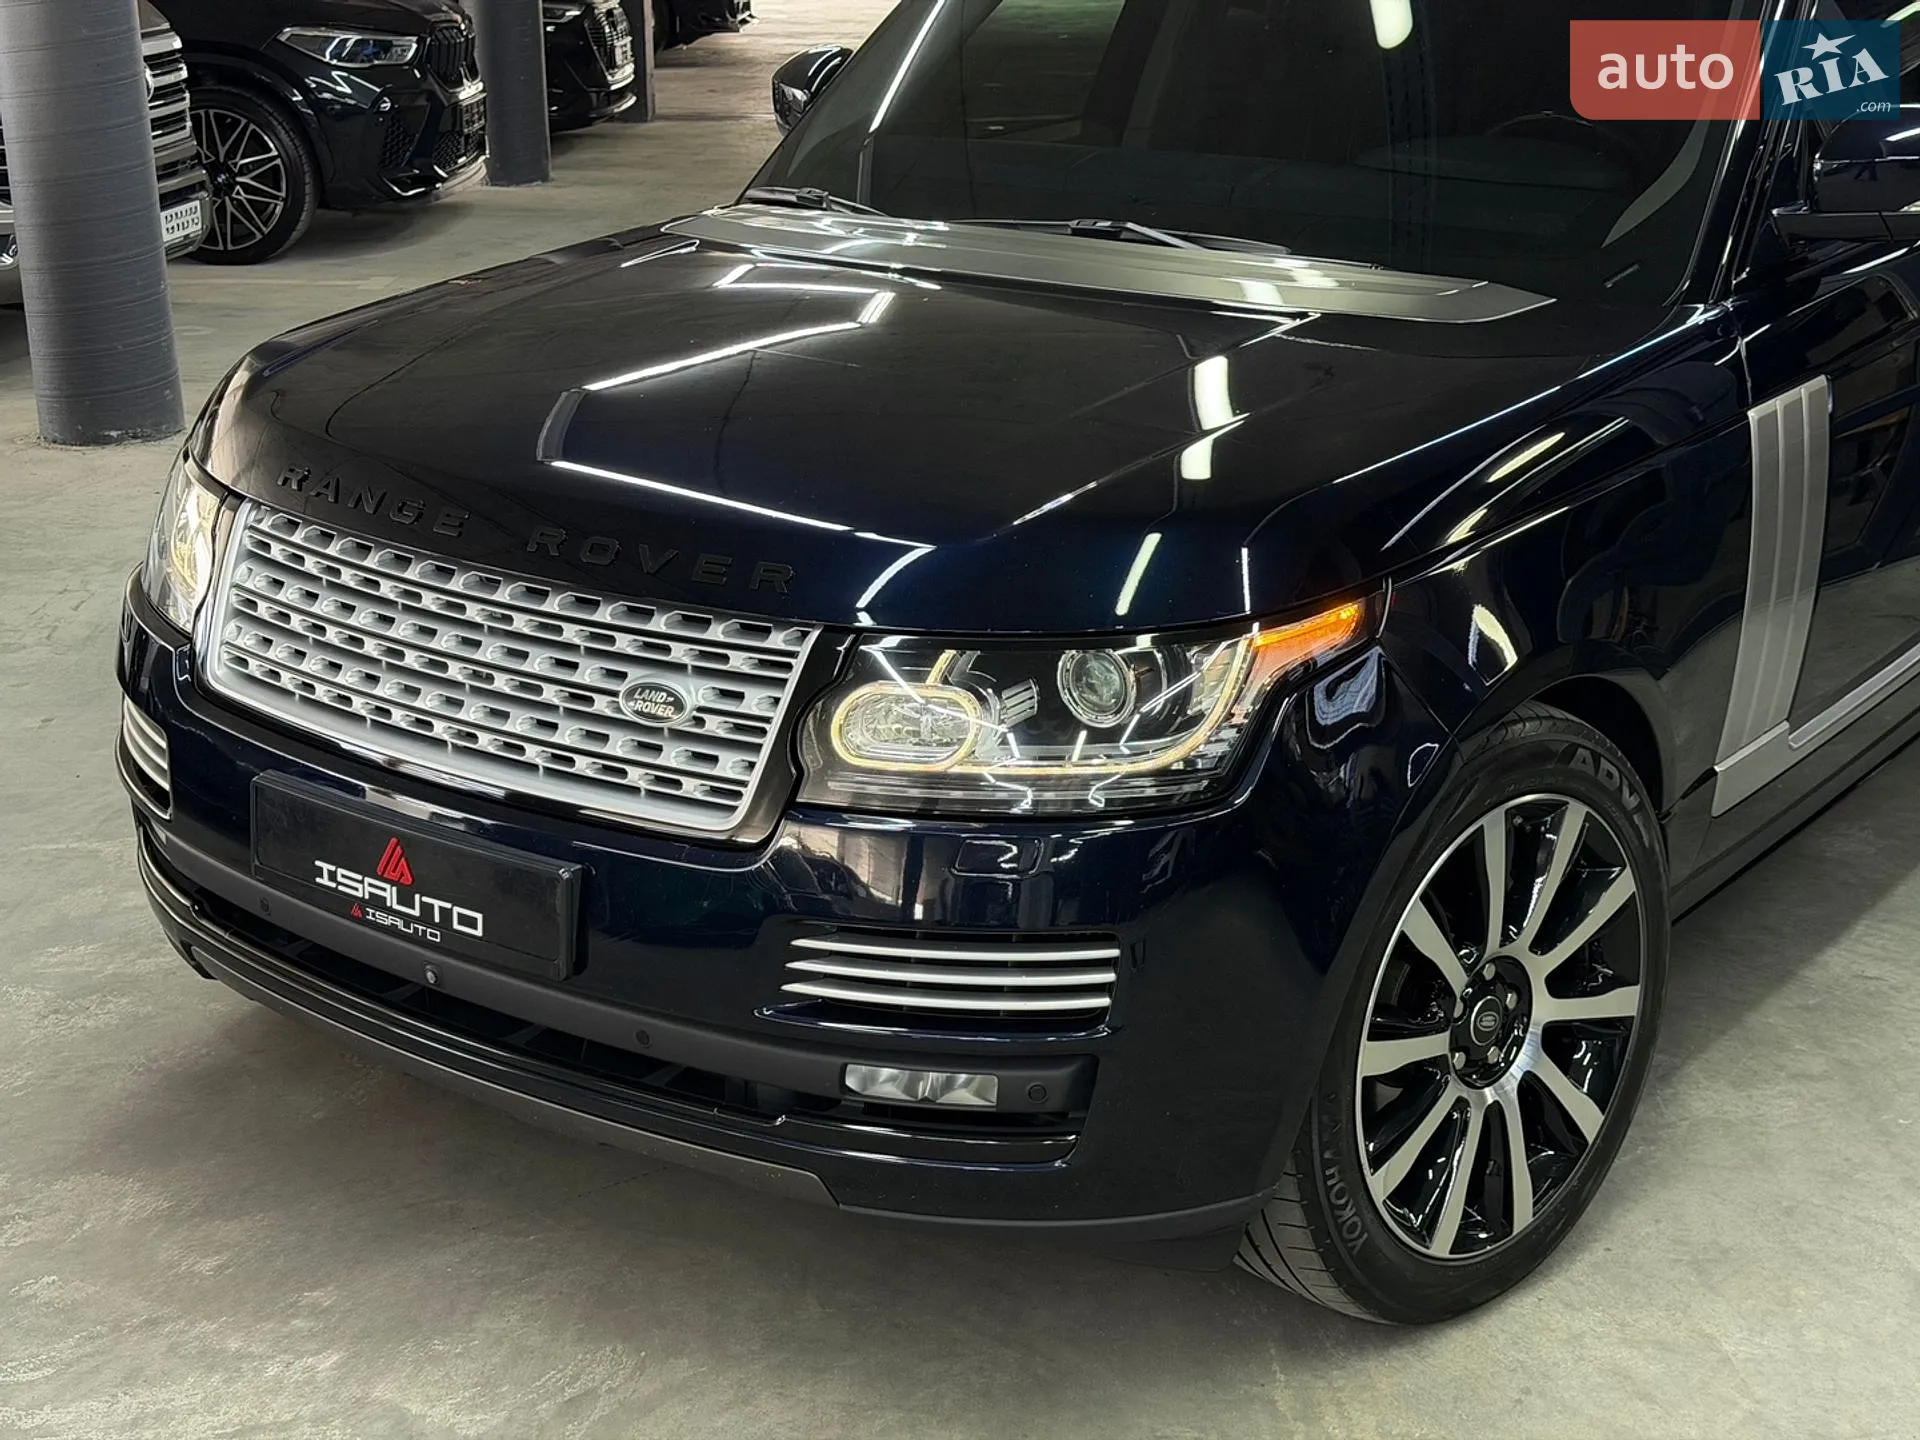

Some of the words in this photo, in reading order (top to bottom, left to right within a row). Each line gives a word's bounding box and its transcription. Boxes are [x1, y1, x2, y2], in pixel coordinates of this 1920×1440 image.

[276, 463, 472, 537] RANGE
[526, 526, 796, 598] ROVER
[314, 860, 483, 937] ISAUTO
[365, 907, 441, 943] ISAUTO
